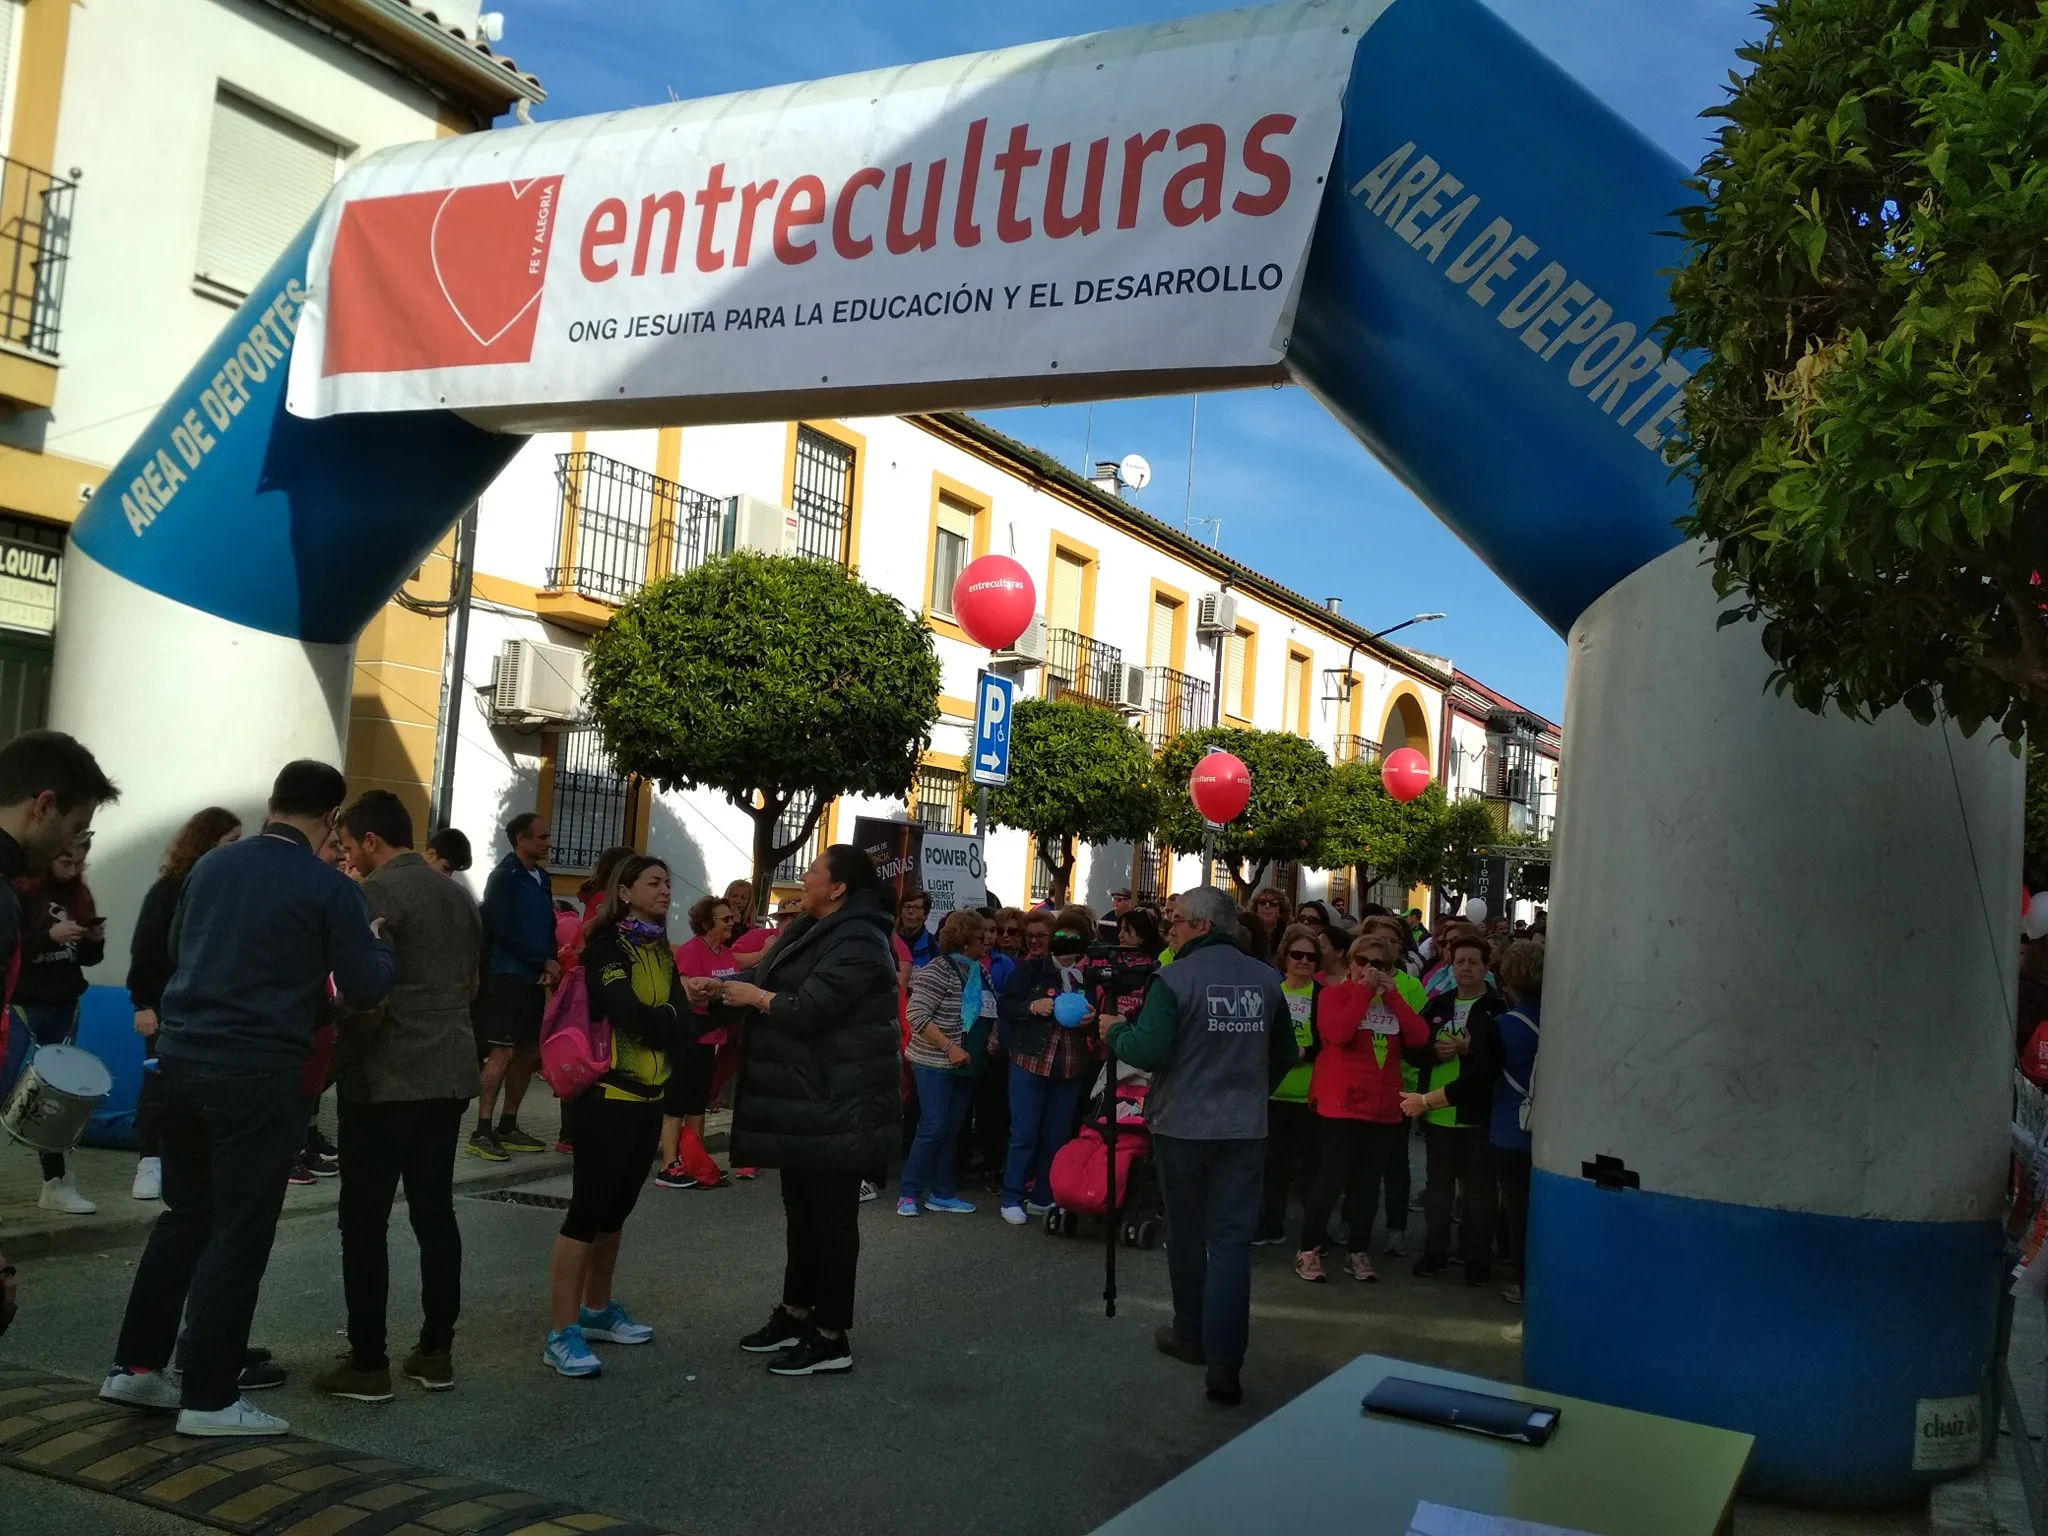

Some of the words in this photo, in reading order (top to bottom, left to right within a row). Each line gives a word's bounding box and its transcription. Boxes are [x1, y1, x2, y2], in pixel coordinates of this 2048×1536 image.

[580, 113, 1298, 283] entreculturas
[534, 184, 555, 244] ALEGRÍA
[1350, 140, 1481, 263] AREA
[1444, 215, 1541, 307] DE
[531, 246, 542, 256] Y
[528, 259, 541, 274] FE
[568, 318, 618, 343] ONG
[623, 311, 717, 339] JESUITA
[724, 306, 786, 333] PARA
[793, 302, 825, 327] LA
[832, 283, 994, 324] EDUCACIÓN
[1004, 286, 1022, 308] Y
[1029, 283, 1064, 308] EL
[1074, 263, 1284, 305] DESARROLLO
[120, 449, 187, 537] AREA
[171, 408, 216, 470] DE
[983, 683, 1006, 739] P
[882, 855, 914, 880] NIÑAS
[925, 847, 968, 866] POWER
[969, 842, 982, 878] 8
[928, 879, 954, 891] LIGHT
[1207, 997, 1237, 1015] TV
[1289, 1003, 1306, 1014] 34
[1207, 1018, 1264, 1032] Beconet
